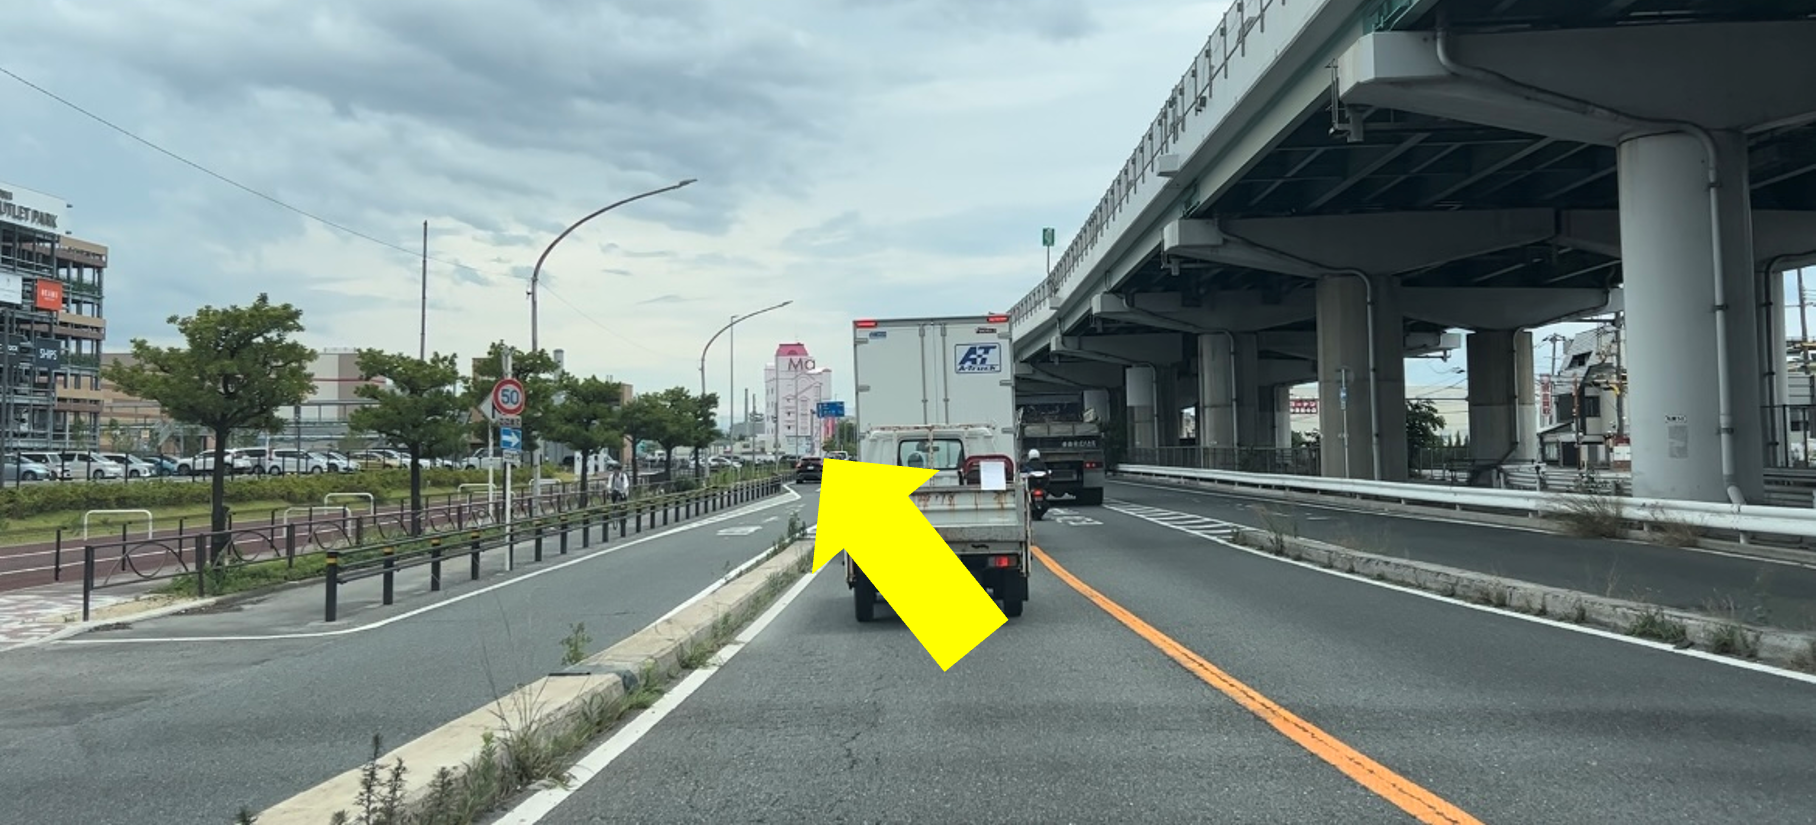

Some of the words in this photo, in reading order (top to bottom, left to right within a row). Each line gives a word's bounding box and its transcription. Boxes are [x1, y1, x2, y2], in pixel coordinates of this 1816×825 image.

[31, 208, 58, 229] PARK
[39, 348, 58, 360] SHIPS
[958, 345, 997, 365] AT
[501, 389, 519, 405] 50
